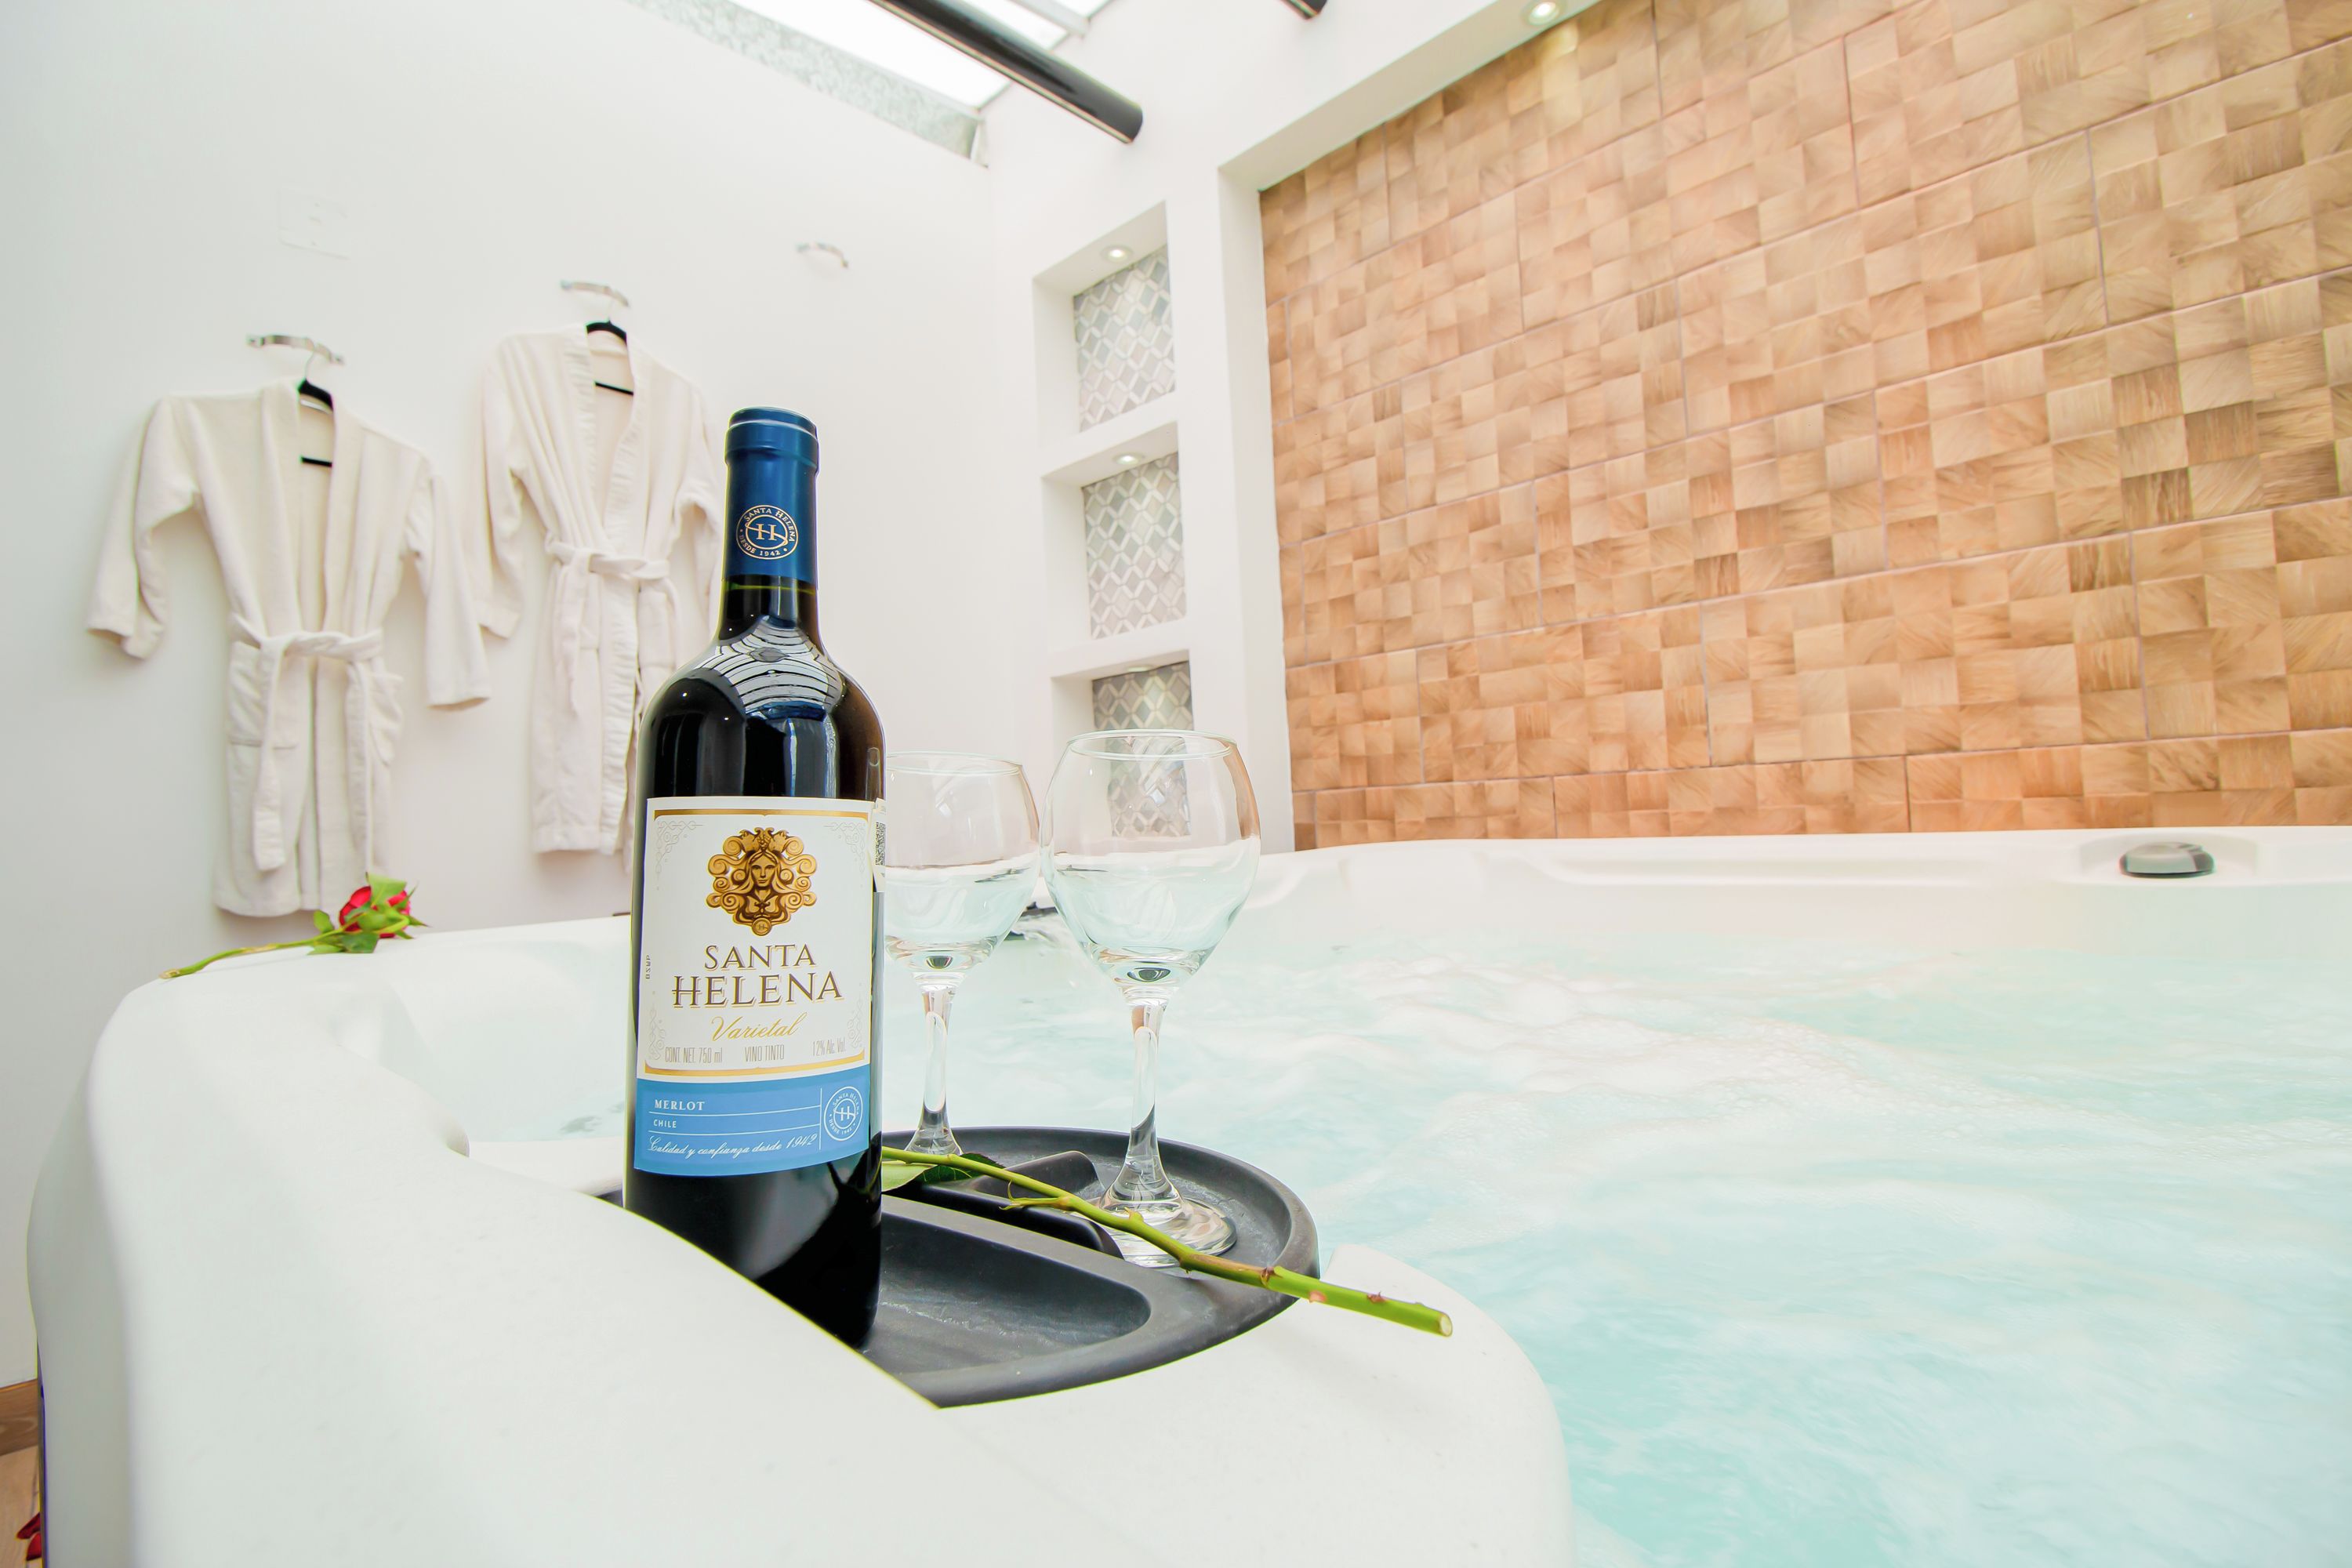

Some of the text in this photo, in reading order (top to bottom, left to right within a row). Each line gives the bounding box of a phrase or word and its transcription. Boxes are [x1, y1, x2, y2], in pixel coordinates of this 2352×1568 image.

[744, 508, 796, 542] SANTA HELENA
[739, 535, 757, 554] DESDE
[704, 944, 816, 971] SANTA
[672, 971, 844, 1008] HELENA
[711, 1012, 808, 1041] Varietal
[699, 1047, 712, 1064] 750
[714, 1047, 723, 1062] ml
[745, 1044, 785, 1062] VINO TINTO
[654, 1099, 705, 1111] MERLOT
[653, 1119, 677, 1128] CHILE
[648, 1133, 818, 1160] Calidad y confianza desde 1942
